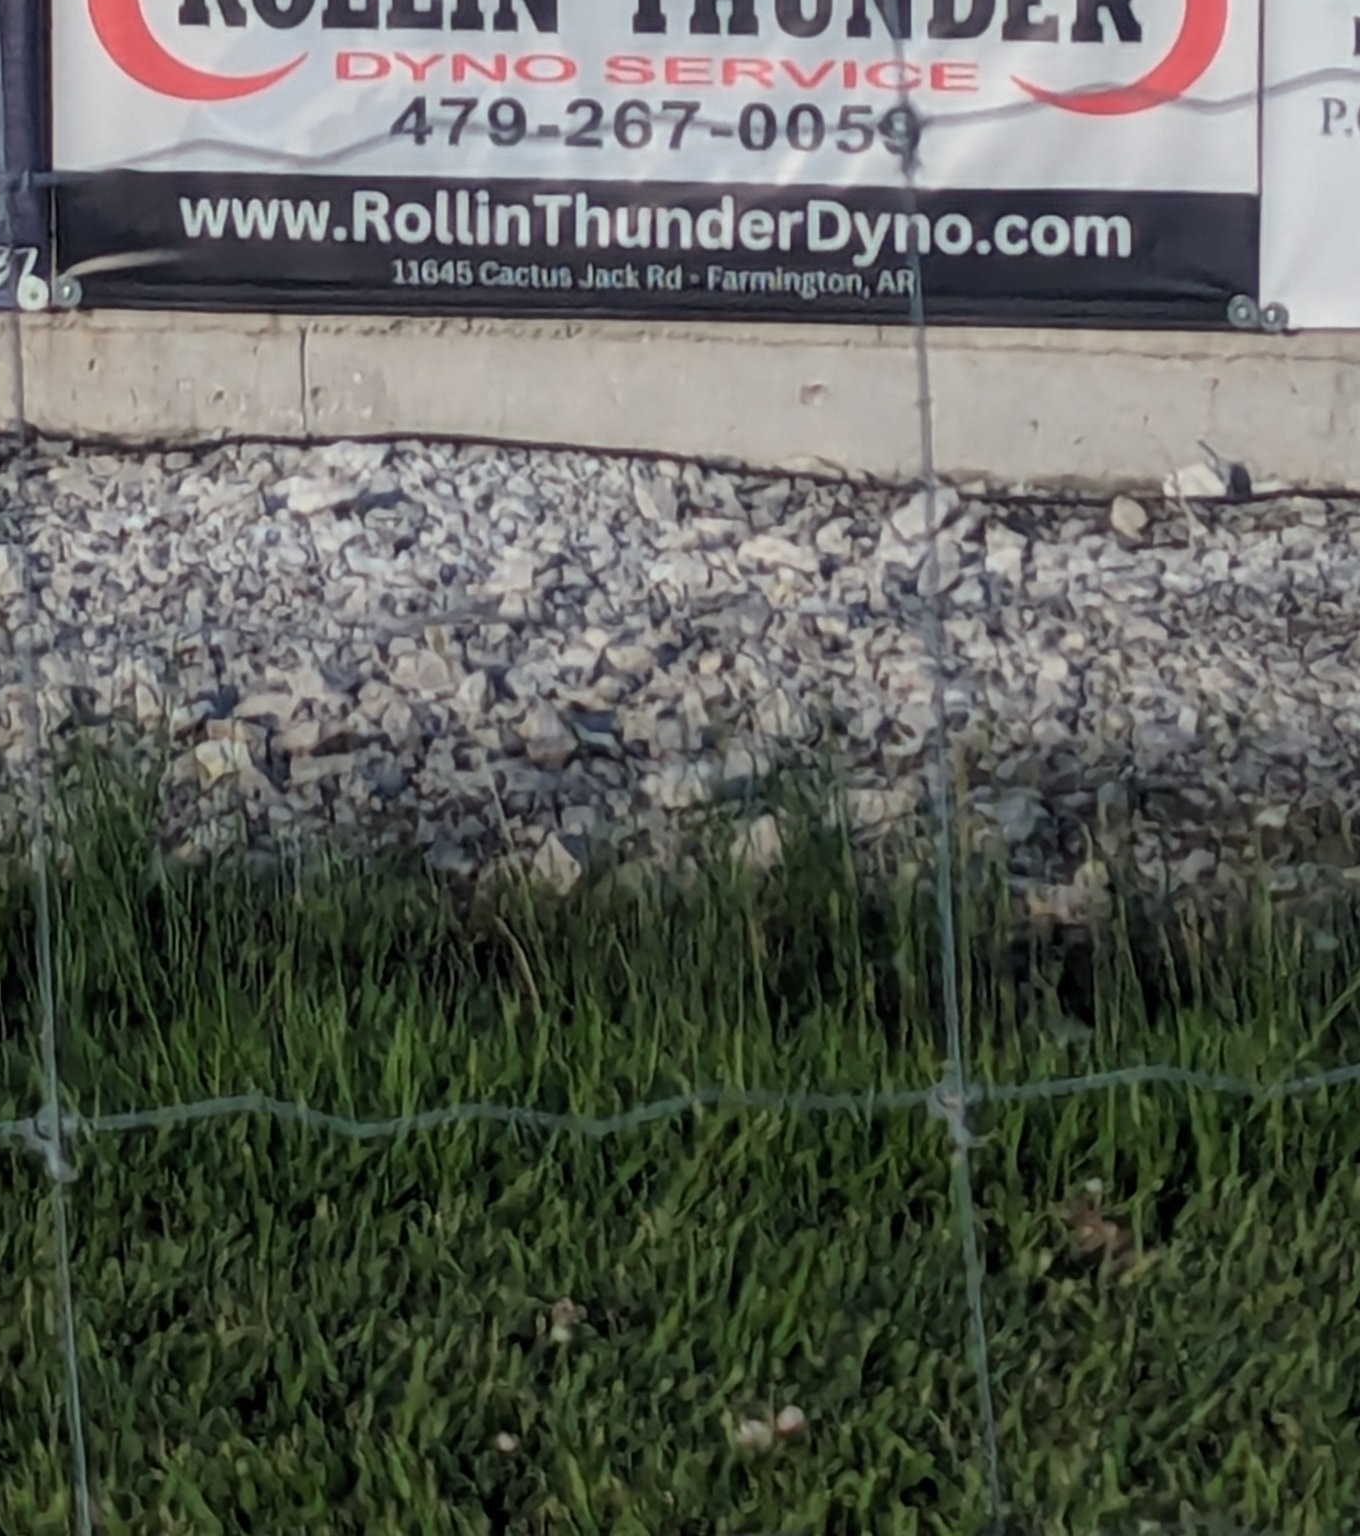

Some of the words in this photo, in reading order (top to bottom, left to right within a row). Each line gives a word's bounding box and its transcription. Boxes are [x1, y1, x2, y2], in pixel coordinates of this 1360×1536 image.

[335, 51, 577, 84] DYNO
[604, 54, 979, 93] SERVICE
[390, 96, 921, 156] 479-267-0059
[179, 190, 1133, 266] www.RollinThunderDyno.com
[391, 258, 474, 287] 11645
[478, 259, 573, 290] Cactus
[578, 260, 640, 292] Jack
[646, 263, 683, 293] Rd
[706, 265, 872, 299] Farmington,
[876, 268, 915, 295] AR
